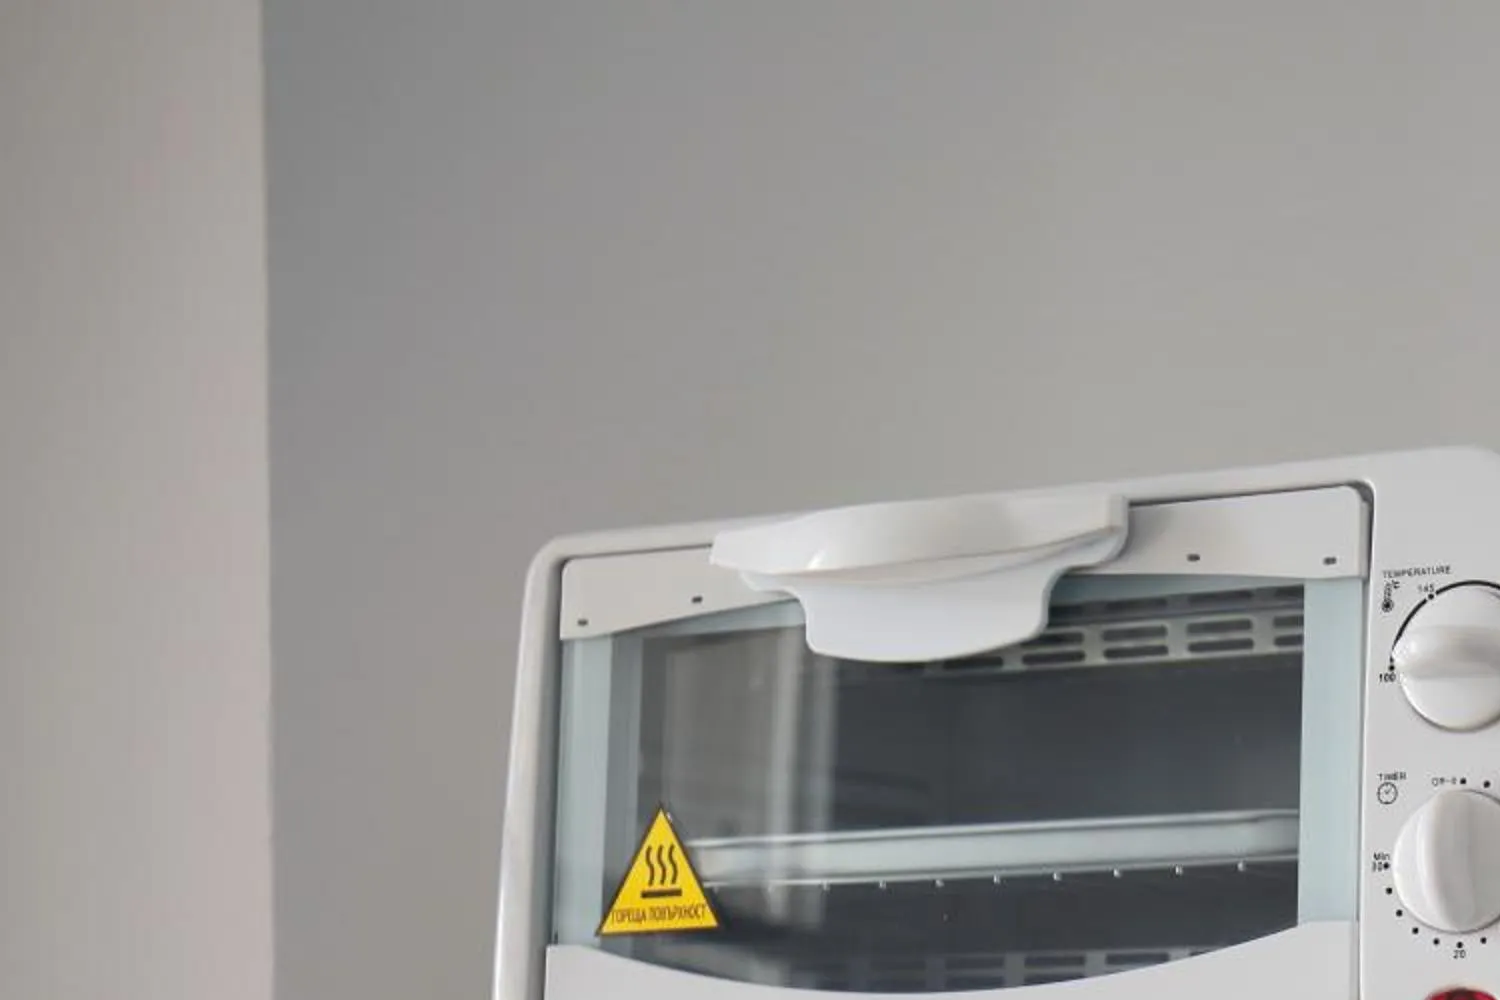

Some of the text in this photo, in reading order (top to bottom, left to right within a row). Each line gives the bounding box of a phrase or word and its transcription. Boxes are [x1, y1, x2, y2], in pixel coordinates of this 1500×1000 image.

[1382, 565, 1451, 579] TEMPERATURE
[1379, 673, 1397, 683] 100
[1377, 771, 1407, 782] TIMER
[1373, 851, 1391, 861] Min
[1452, 949, 1466, 959] 20
